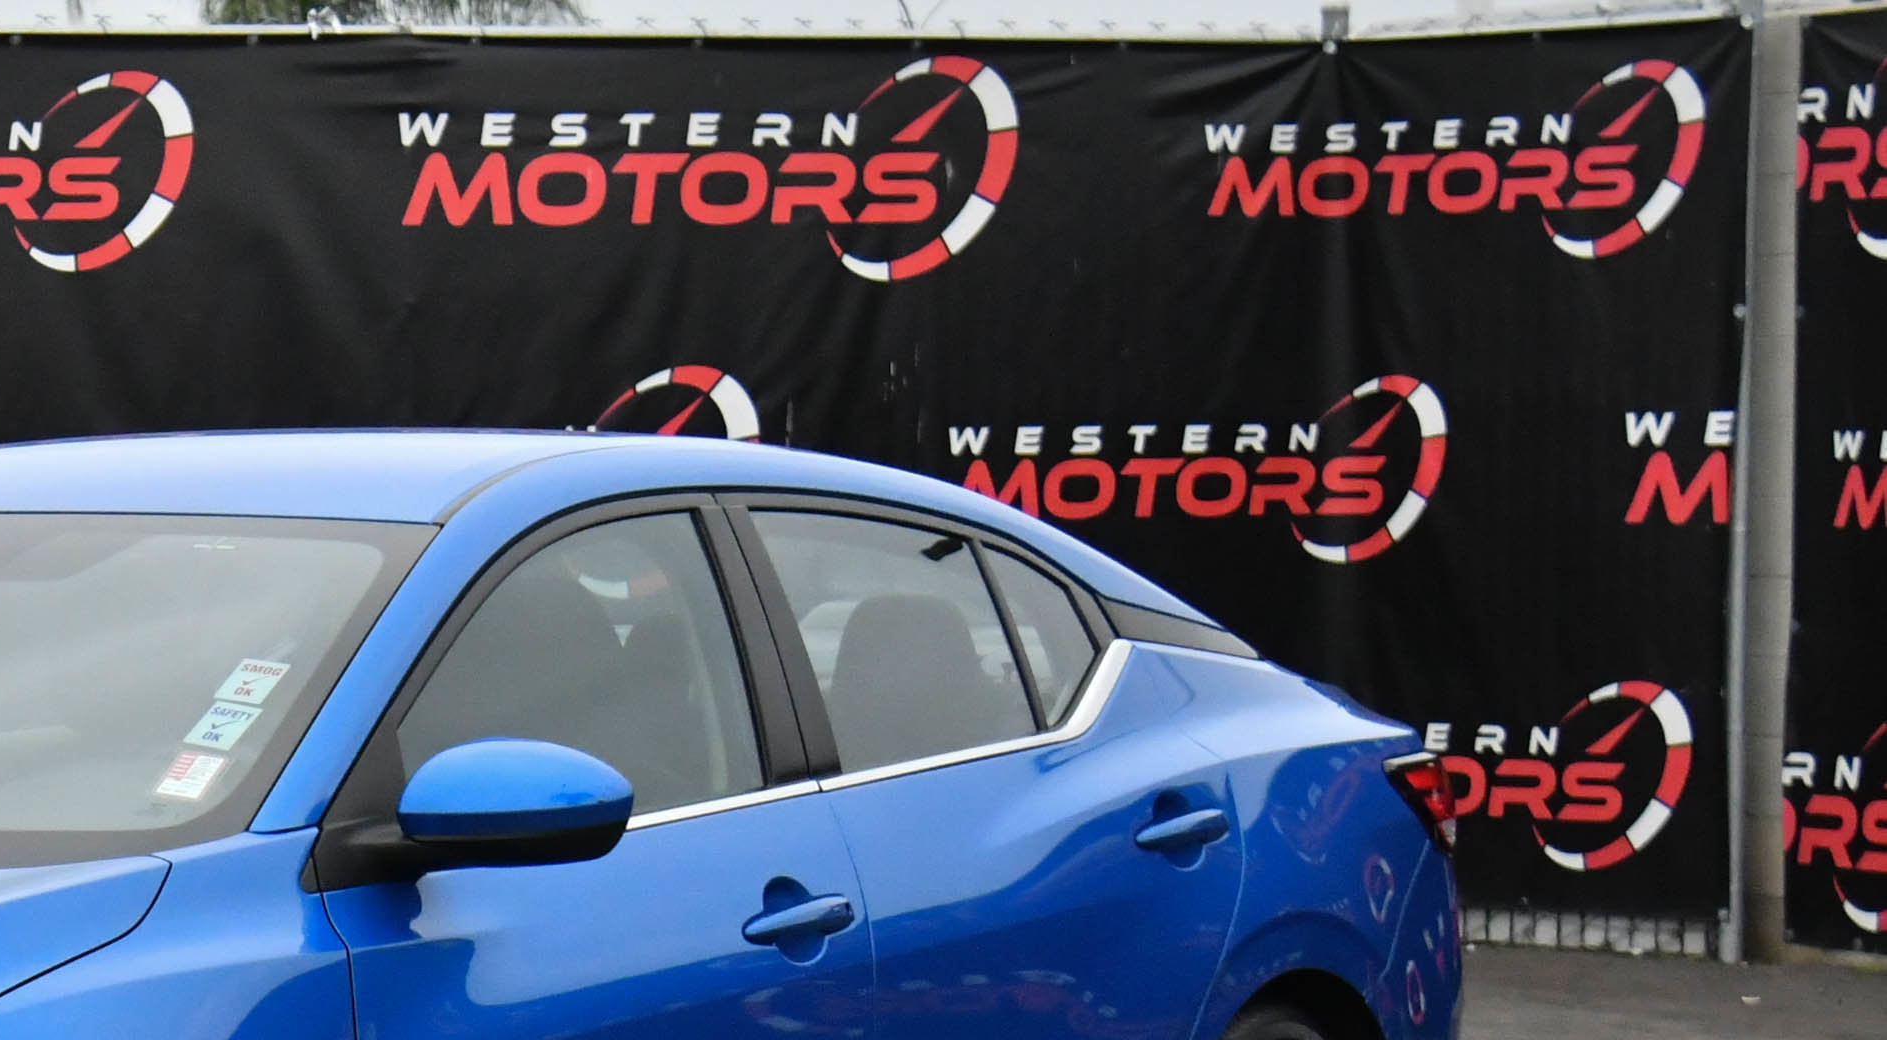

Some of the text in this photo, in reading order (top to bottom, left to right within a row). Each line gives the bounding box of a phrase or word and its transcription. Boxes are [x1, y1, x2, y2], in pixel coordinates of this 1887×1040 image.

[398, 112, 858, 147] WESTERN
[1204, 113, 1572, 153] WESTERN
[402, 151, 940, 227] MOTORS
[1208, 144, 1637, 218] MOTORS
[948, 423, 1318, 456] WESTERN
[962, 455, 1386, 519] MOTORS
[240, 663, 283, 677] SMOG
[233, 686, 254, 697] OK
[210, 706, 255, 721] SAFETY
[201, 731, 223, 743] OK
[1424, 722, 1558, 755] ERN
